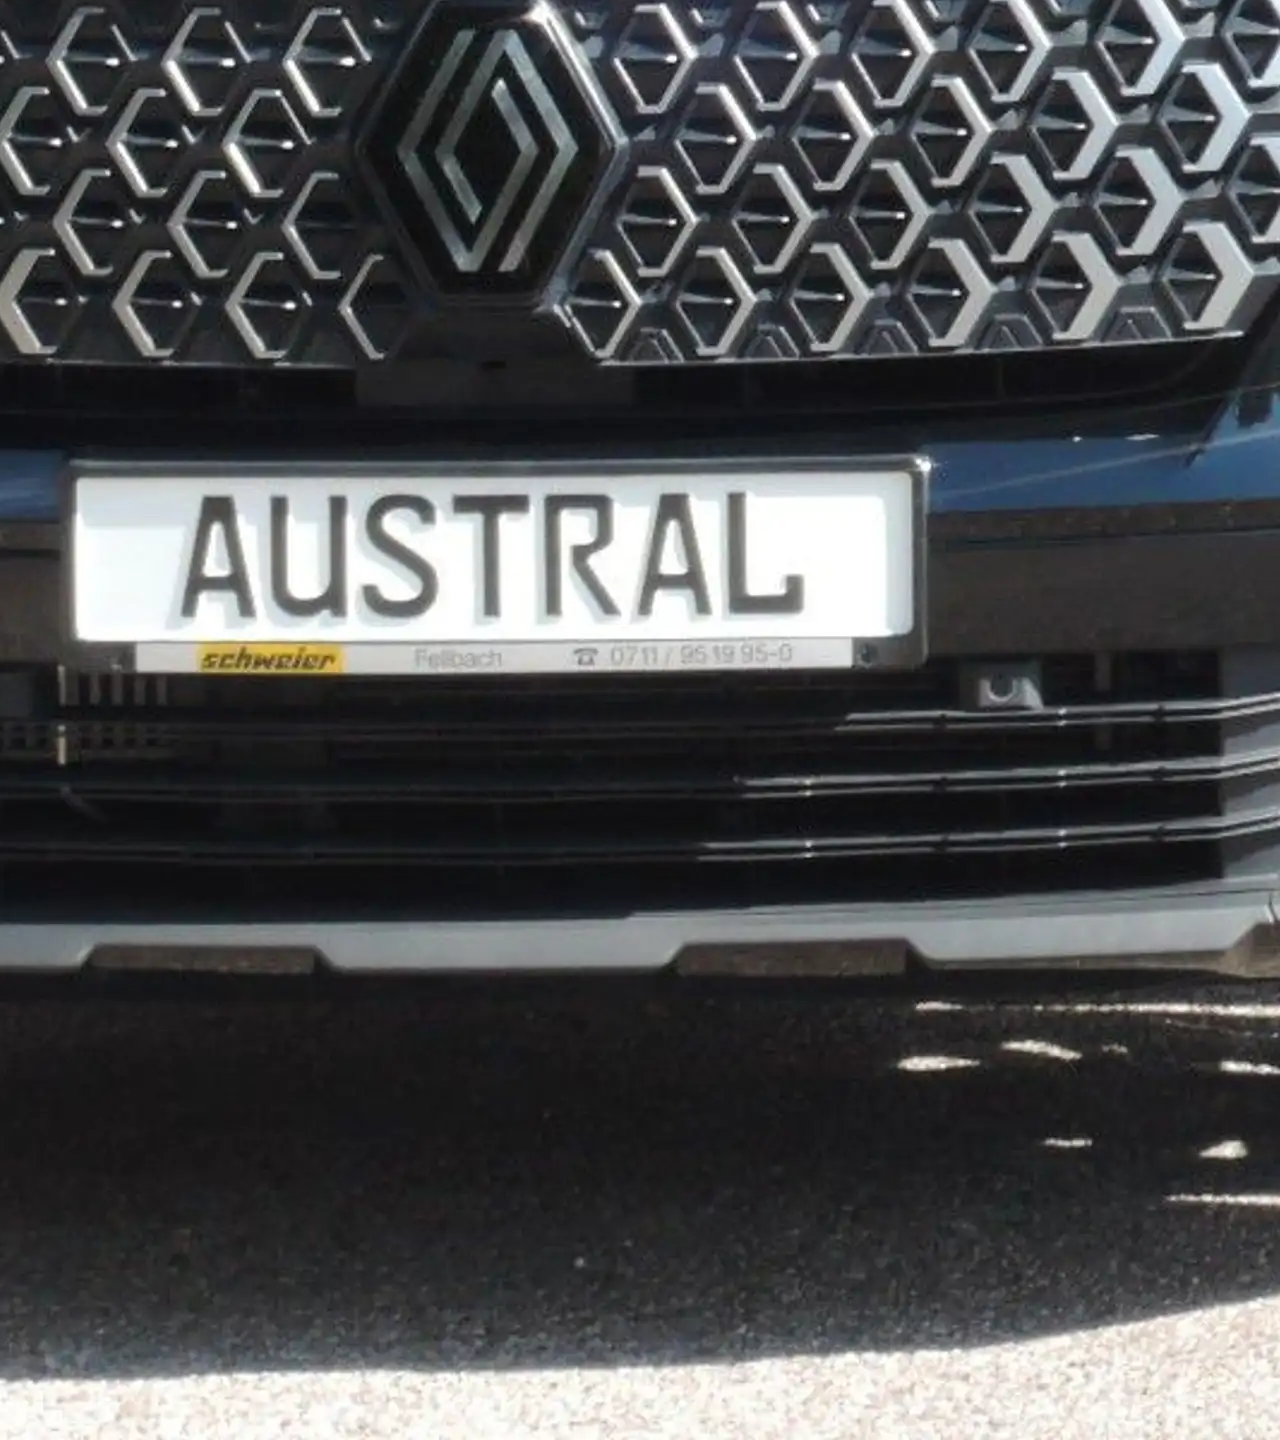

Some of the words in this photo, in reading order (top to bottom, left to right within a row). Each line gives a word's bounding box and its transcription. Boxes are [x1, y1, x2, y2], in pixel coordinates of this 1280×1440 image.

[179, 491, 806, 620] AUSTRAL
[200, 645, 337, 670] schweier
[414, 647, 503, 668] Fellbach
[609, 646, 658, 666] 0711
